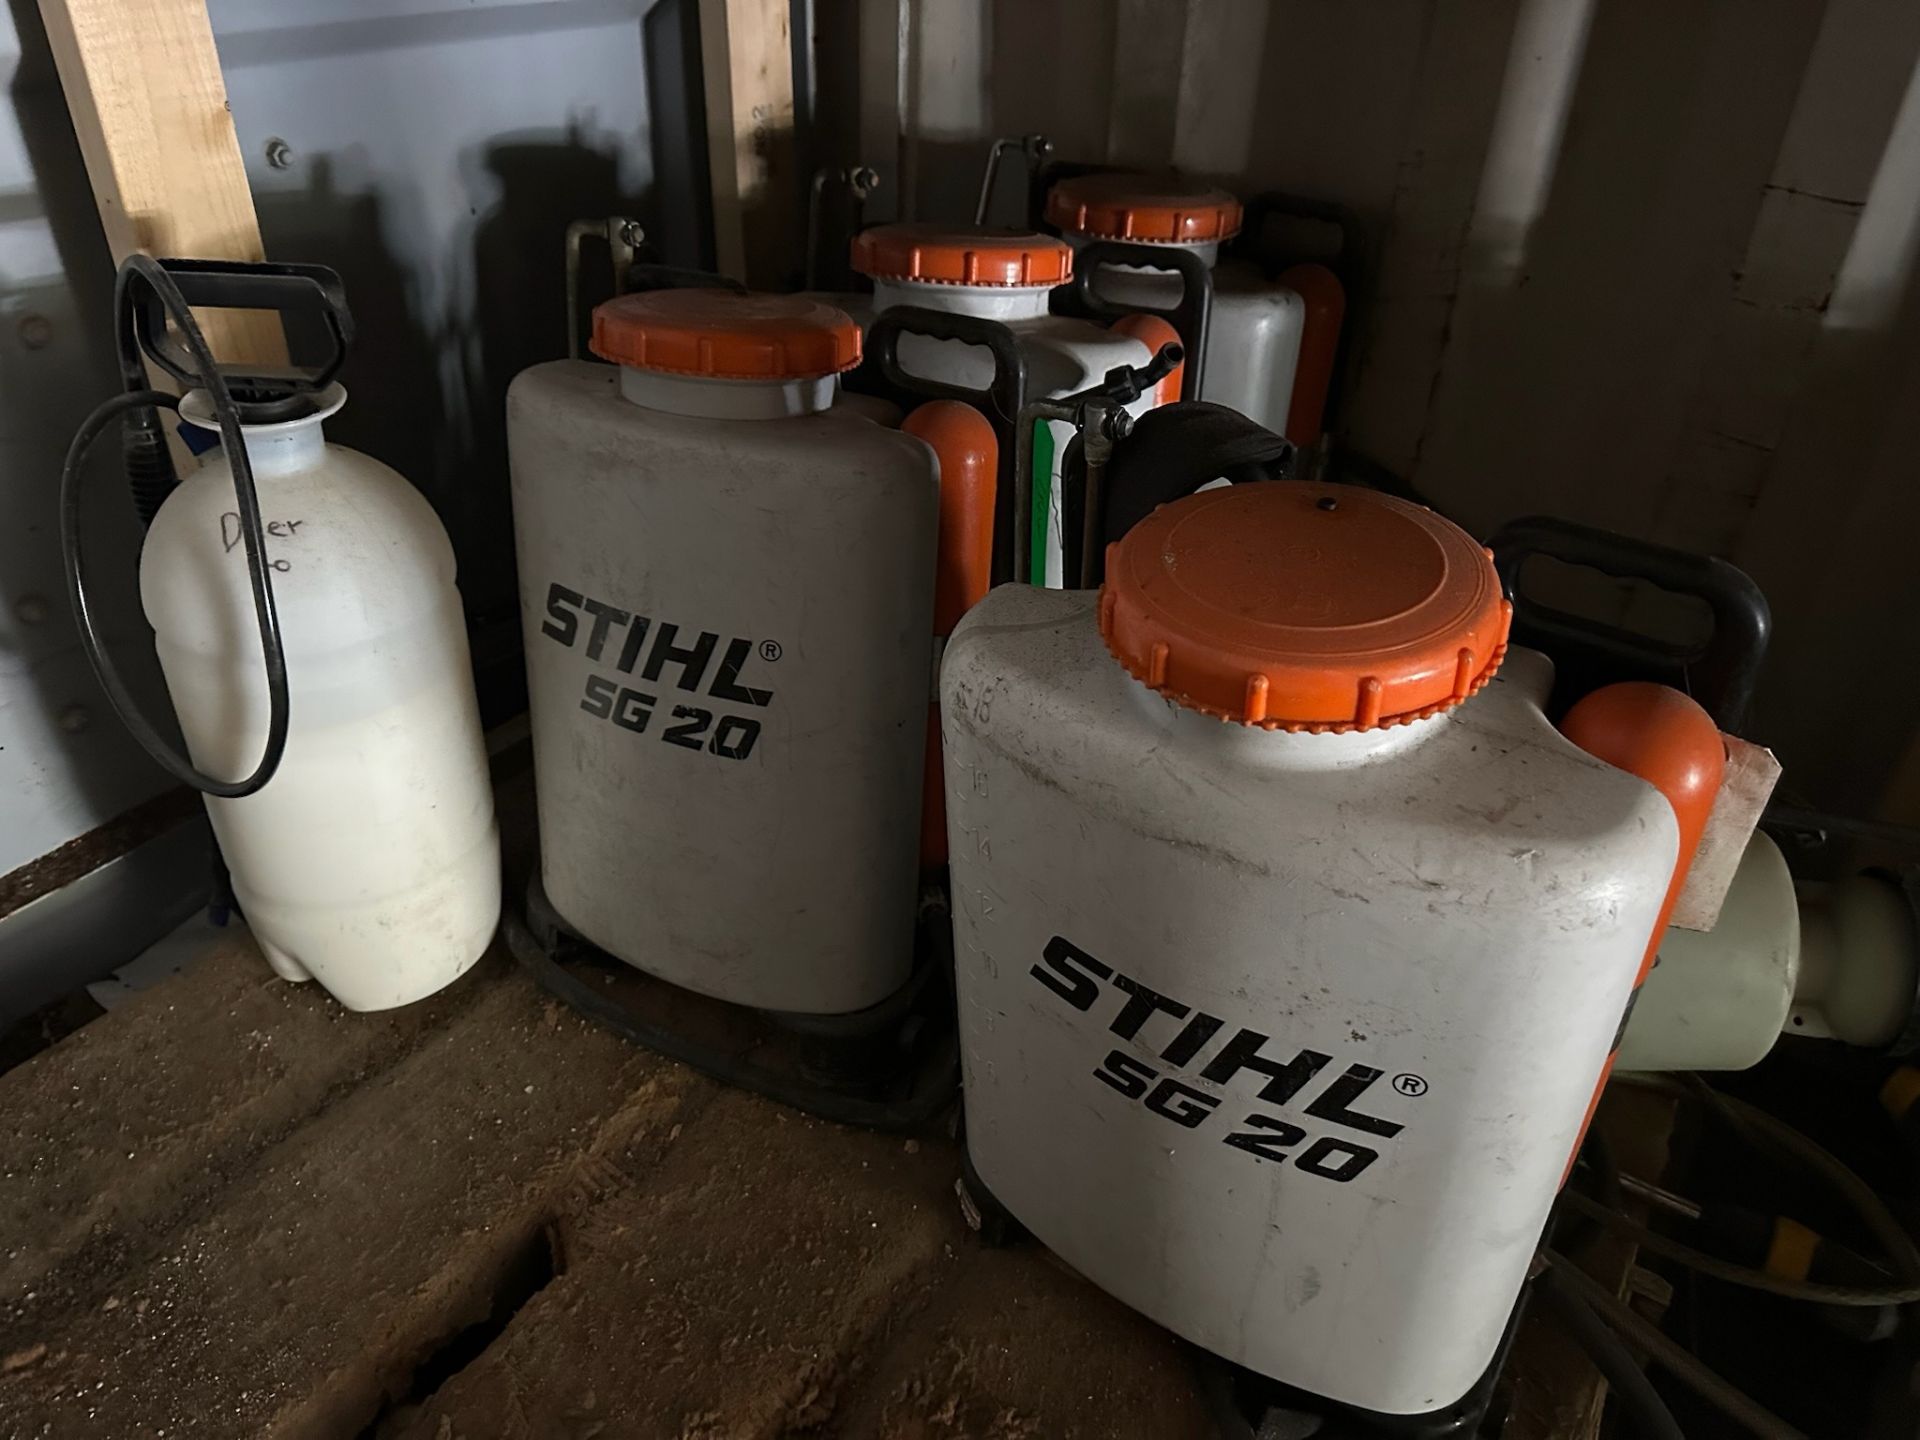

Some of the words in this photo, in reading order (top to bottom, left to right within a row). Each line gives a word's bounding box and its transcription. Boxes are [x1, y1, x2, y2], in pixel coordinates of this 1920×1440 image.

[580, 673, 657, 734] SG
[661, 704, 761, 760] 20
[1092, 1049, 1222, 1129] SG
[1222, 1113, 1379, 1183] 20
